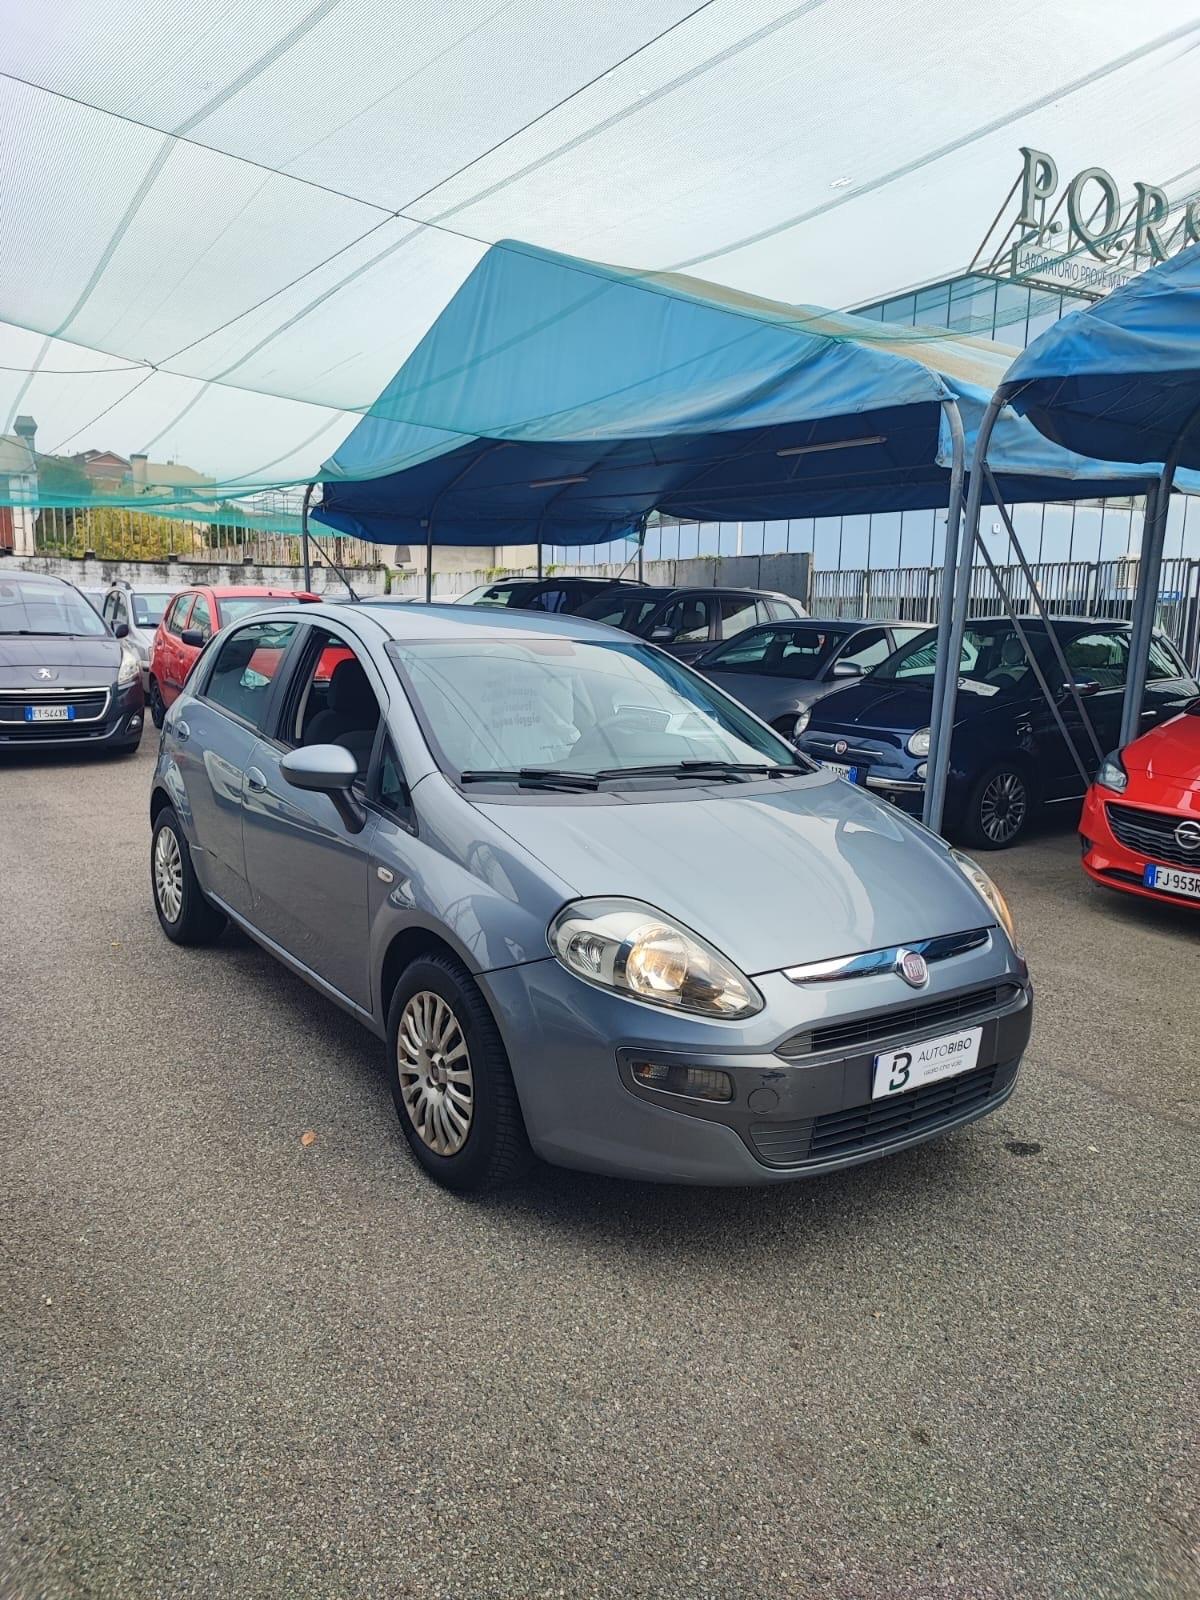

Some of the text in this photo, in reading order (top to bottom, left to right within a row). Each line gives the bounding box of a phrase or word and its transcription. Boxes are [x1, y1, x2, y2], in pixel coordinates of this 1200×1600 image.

[1019, 252, 1079, 281] LABORATORIO
[1080, 267, 1107, 288] PROVE
[917, 1037, 972, 1063] AUTOBIBO
